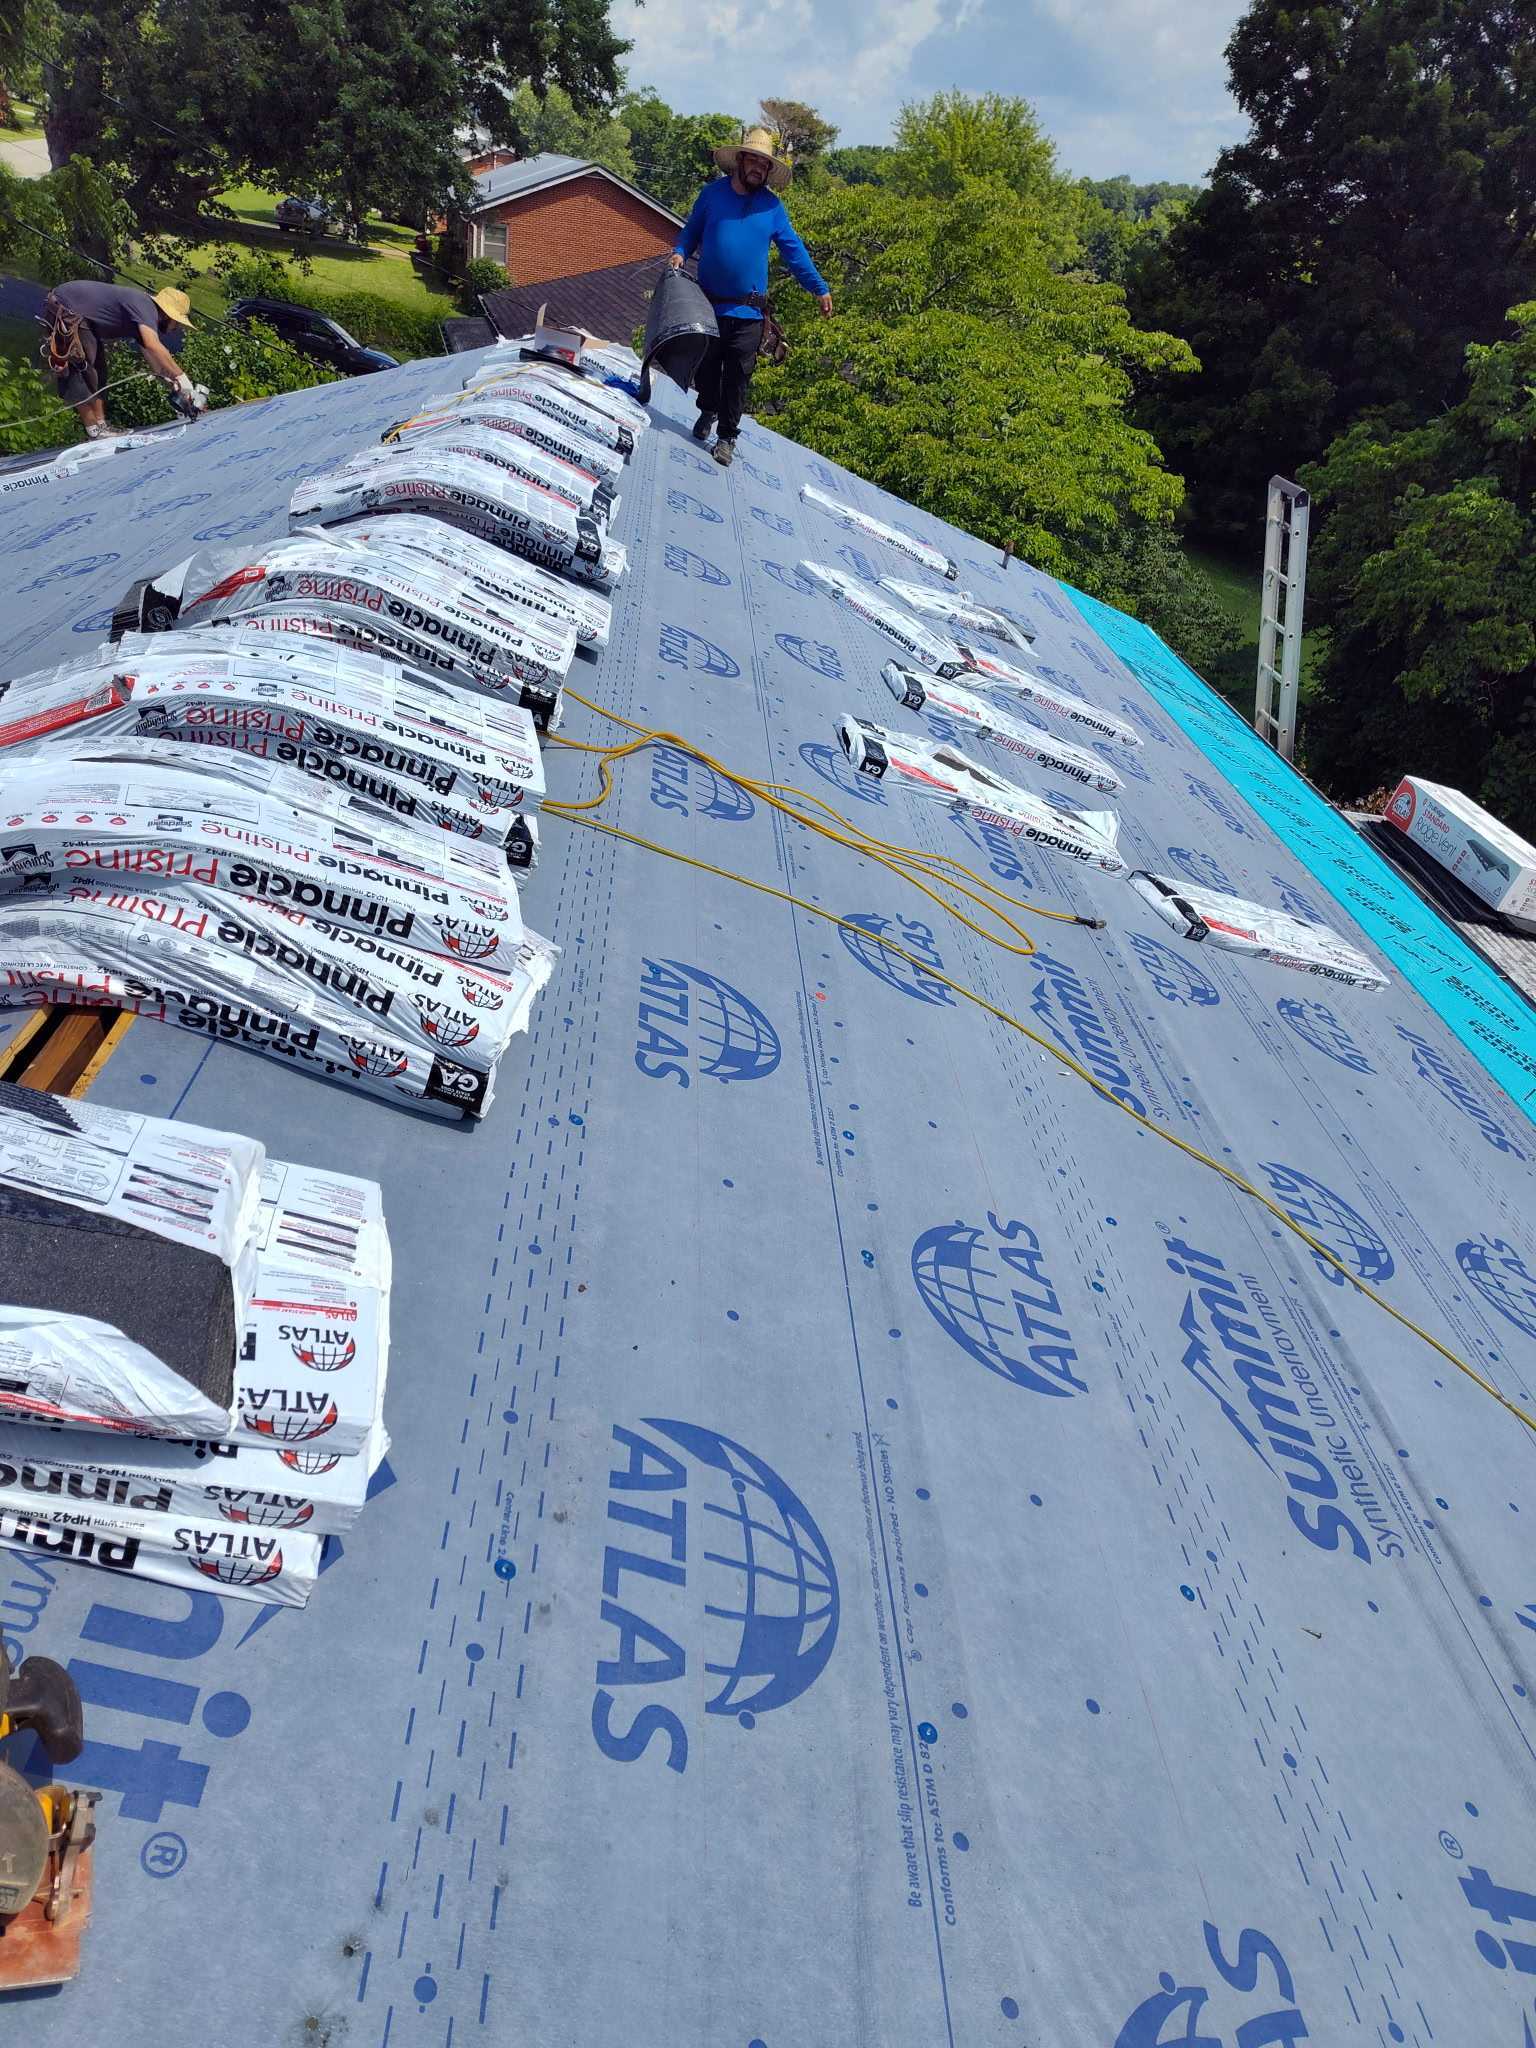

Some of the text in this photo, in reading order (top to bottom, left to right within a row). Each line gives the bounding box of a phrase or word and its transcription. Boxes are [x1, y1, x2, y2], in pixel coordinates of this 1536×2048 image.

[535, 394, 587, 427] Pinnacle
[526, 427, 582, 463] Pinnacle
[3, 474, 50, 493] Pinnacle
[449, 490, 530, 531] Pinnacle
[297, 579, 497, 666] Pinnacle Pristine
[443, 606, 523, 647] Pinnacle
[873, 618, 917, 653] Pinnacle
[658, 622, 689, 671] ATLAS
[289, 690, 486, 766] Pinnacle Pristine
[1069, 711, 1117, 739] Pinnacle
[186, 705, 459, 793] Pinnacle Pristine
[993, 734, 1092, 783] Pinnacle Pristine
[276, 741, 418, 817] Pinnacle
[471, 772, 522, 795] ATLAS
[650, 750, 689, 818] ATLAS
[864, 761, 882, 776] GA
[430, 799, 481, 828] ATLAS
[1422, 811, 1450, 834] STANDARD
[200, 822, 311, 863] Pristine
[970, 806, 1093, 861] Pinnacle Pristine
[1415, 816, 1457, 857] Ridge Vent
[64, 848, 219, 886] Pristine
[204, 847, 232, 859] HP42
[317, 855, 450, 906] Pinnacle
[229, 864, 416, 940] Pinnacle
[460, 894, 503, 913] ATLAS
[432, 913, 496, 939] ATLAS
[217, 920, 396, 1017] Pinnacle
[311, 919, 444, 988] Pinnacle
[346, 961, 370, 977] HP42
[895, 912, 960, 1008] ATLAS
[1128, 930, 1189, 1008] ATLAS
[456, 975, 503, 1001] ATLAS
[1309, 963, 1357, 987] Pinnacle
[123, 979, 321, 1052] Pinnacle
[407, 992, 477, 1027] ATLAS
[634, 956, 690, 1089] ATLAS
[338, 1034, 405, 1063] ATLAS
[1030, 950, 1147, 1119] Summit
[1085, 975, 1171, 1122] Synthetic Underlayment
[1302, 997, 1379, 1077] ATLAS
[439, 1067, 479, 1092] GA
[987, 1210, 1089, 1394] ATLAS
[278, 1324, 350, 1346] ATLAS
[237, 1387, 330, 1414] ATLAS
[1163, 1236, 1372, 1566] Summit
[1238, 1272, 1406, 1560] Synthetic Underlayment
[88, 1464, 126, 1479] HP42
[879, 1449, 893, 1485] Staples
[203, 1484, 309, 1509] ATLAS
[885, 1486, 896, 1504] NO
[52, 1511, 92, 1527] HP42
[93, 1517, 119, 1529] WITH
[172, 1527, 277, 1560] ATLAS
[889, 1513, 904, 1564] Required
[591, 1423, 689, 1775] ATLAS
[879, 1632, 888, 1645] on
[879, 1646, 897, 1699] dependent
[886, 1699, 900, 1722] vary
[889, 1724, 903, 1746] may
[892, 1747, 909, 1801] resistance
[897, 1803, 913, 1823] slip
[900, 1824, 915, 1850] that
[922, 1763, 957, 1926] Conforms to: ASTM D
[904, 1852, 920, 1889] aware
[908, 1892, 922, 1908] Be
